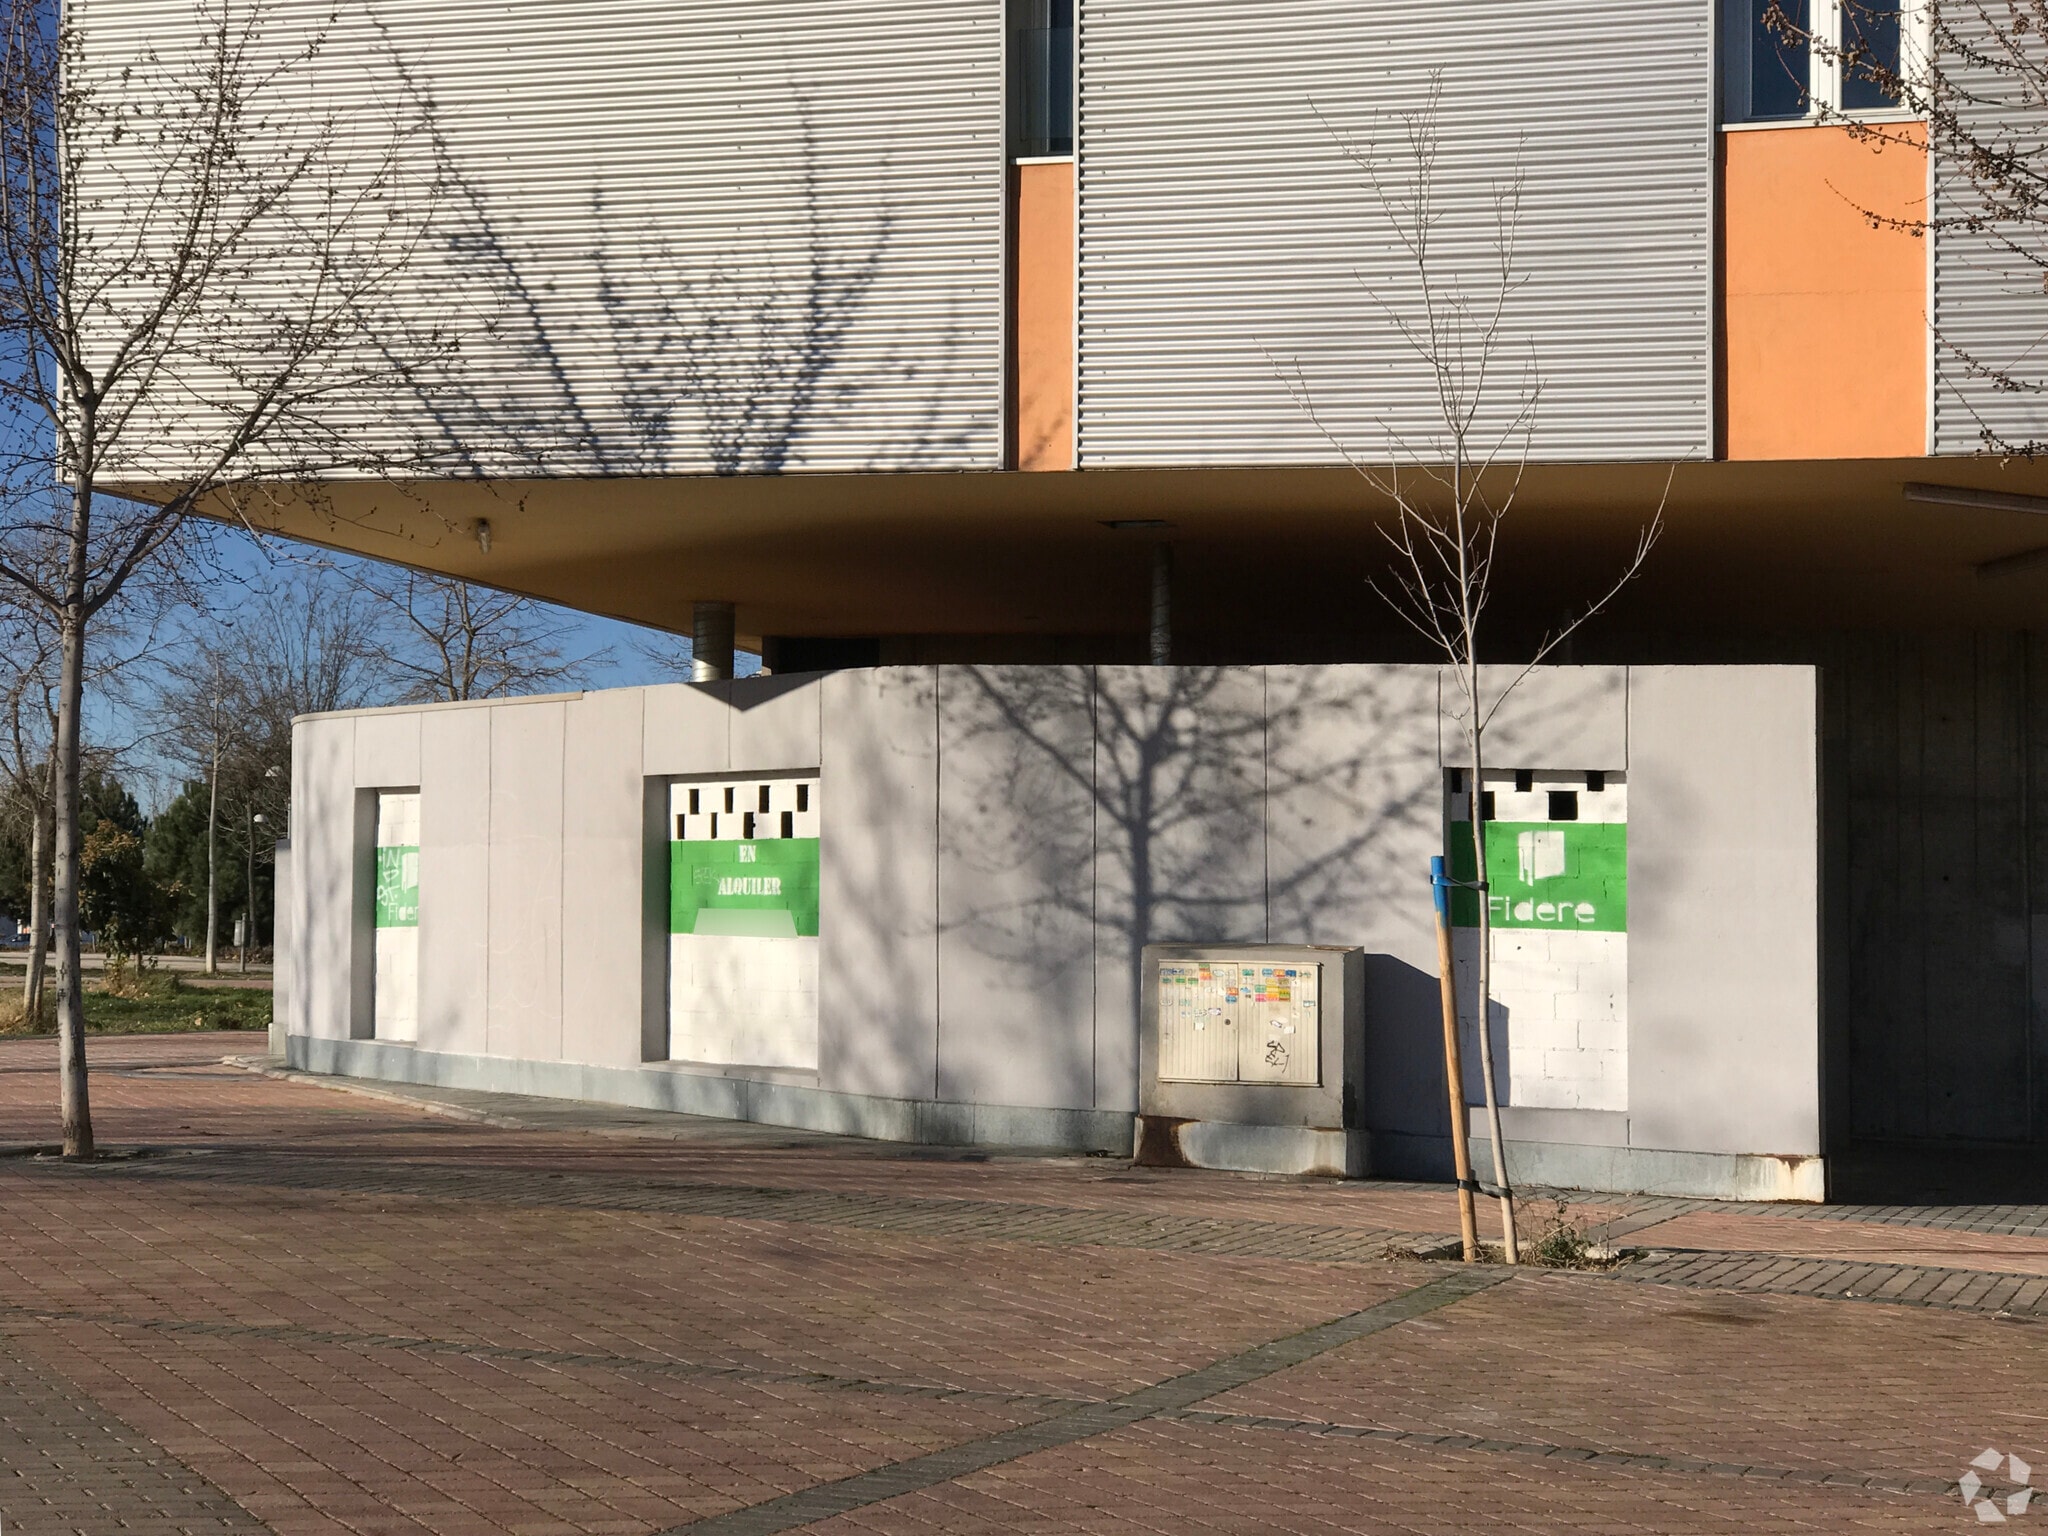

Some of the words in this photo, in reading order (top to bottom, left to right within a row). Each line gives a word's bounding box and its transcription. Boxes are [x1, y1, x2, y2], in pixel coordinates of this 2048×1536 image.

[739, 844, 757, 863] EN
[718, 877, 782, 896] ALQUILER
[1488, 895, 1596, 924] Fidere
